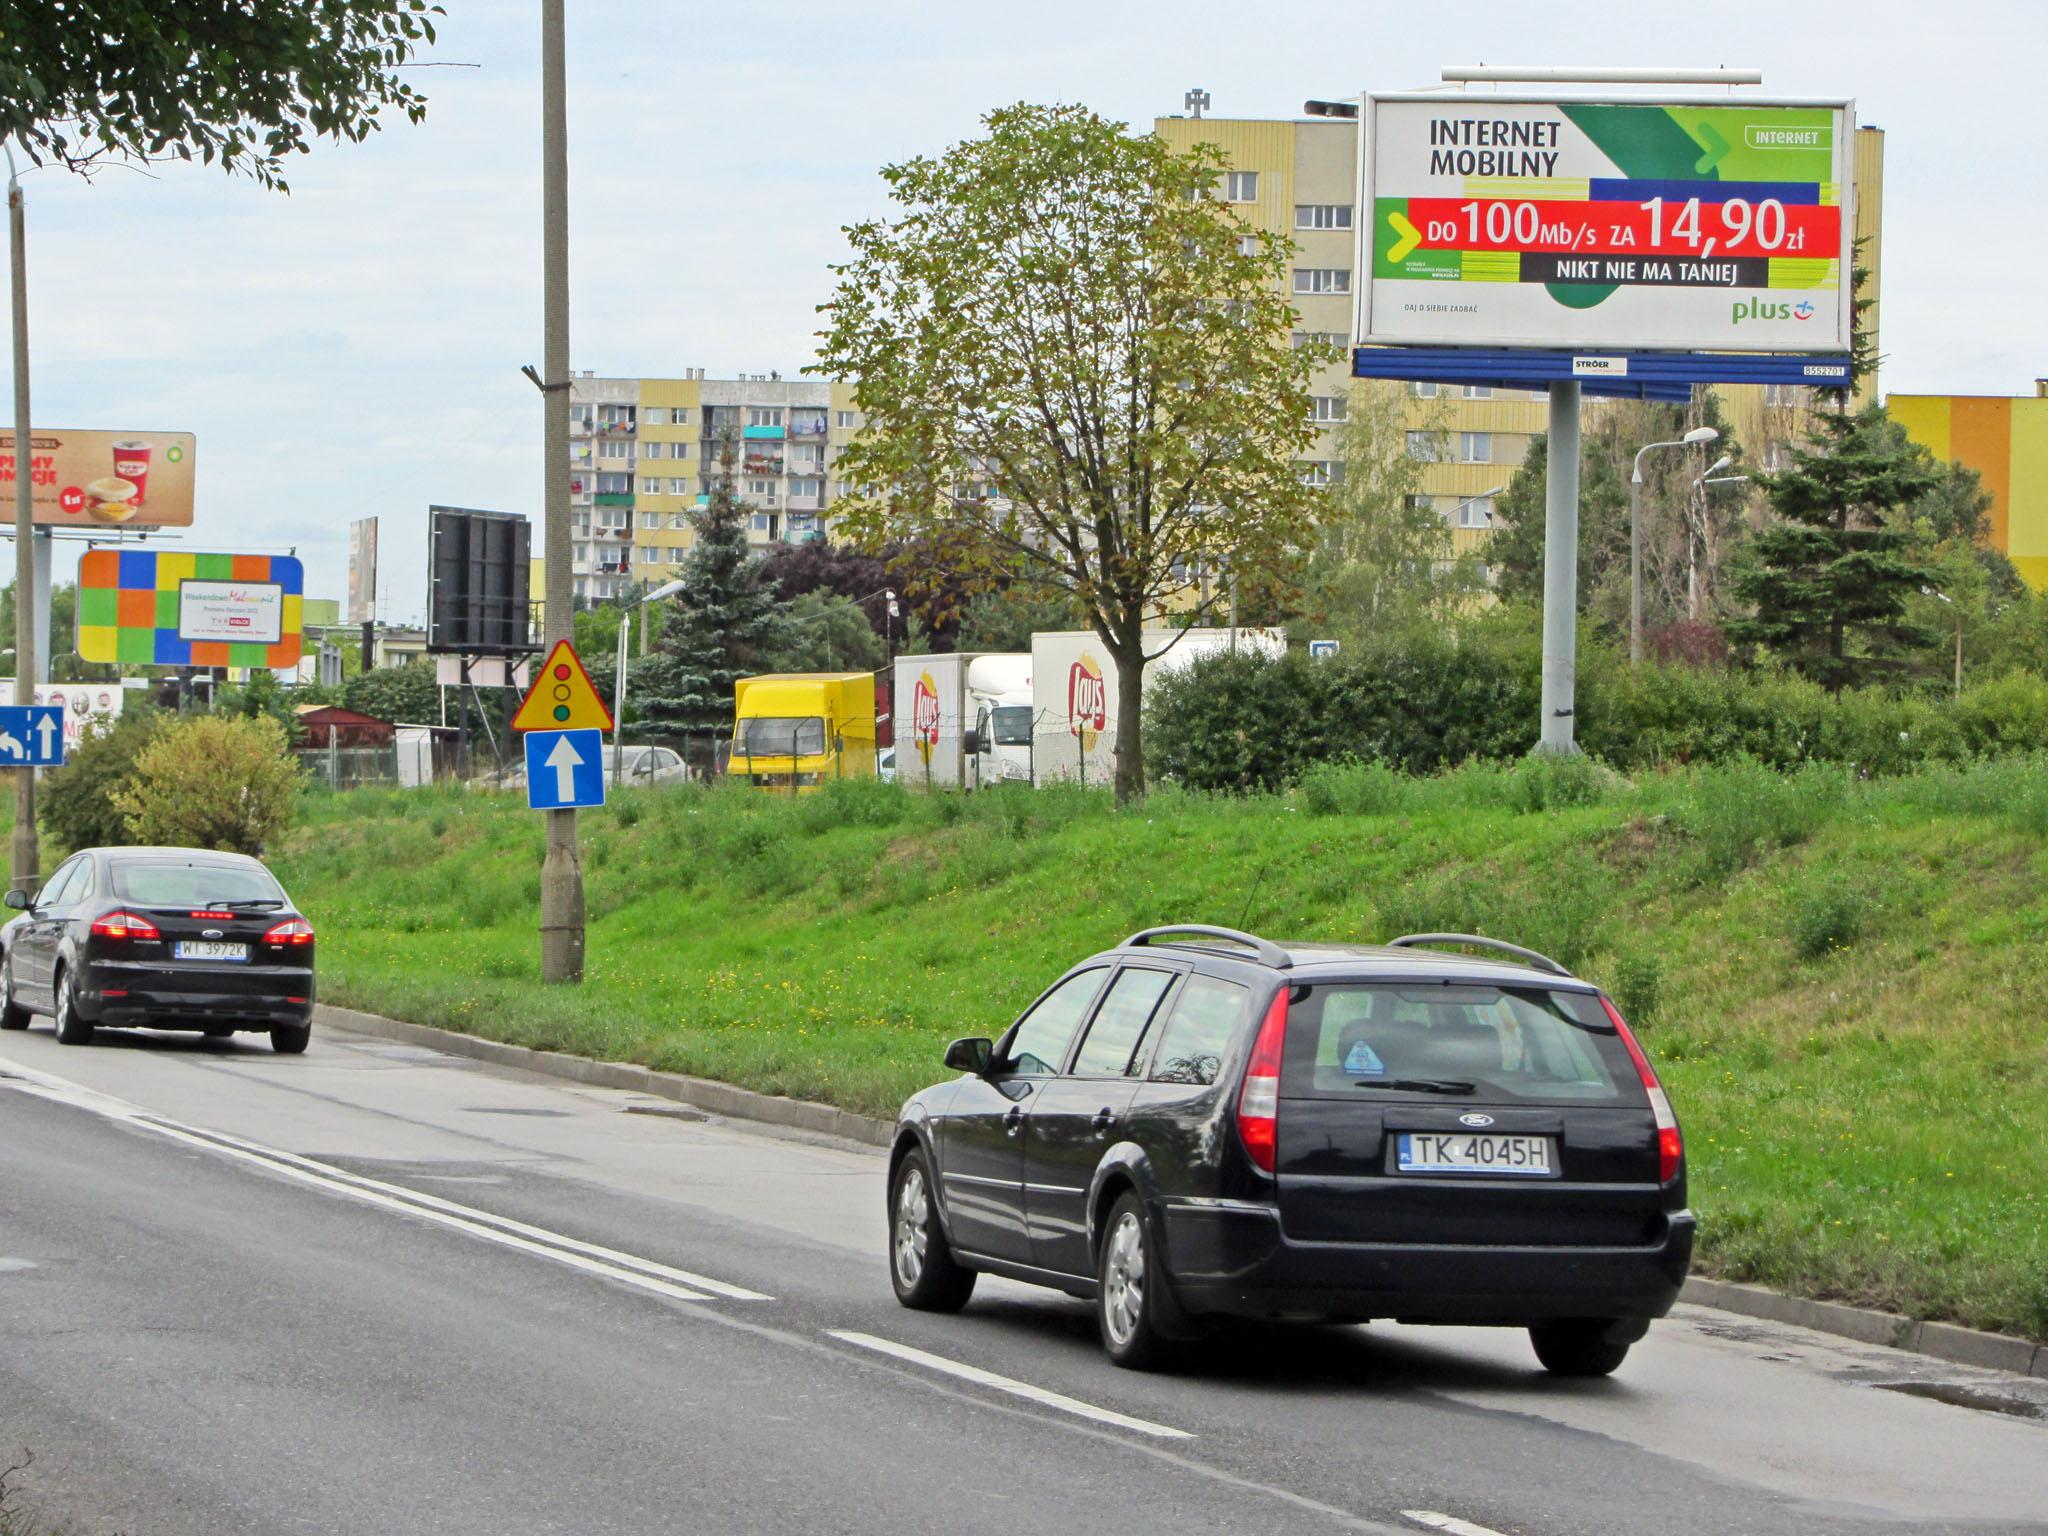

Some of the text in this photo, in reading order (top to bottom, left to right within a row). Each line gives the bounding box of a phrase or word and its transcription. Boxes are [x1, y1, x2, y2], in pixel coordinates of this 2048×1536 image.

[1430, 119, 1561, 148] INTERNET
[1430, 149, 1559, 178] MOBILNY
[1427, 220, 1457, 242] DO
[1609, 225, 1636, 247] ZA
[1557, 260, 1738, 286] NIKT NIE MA TANIEJ
[1404, 303, 1417, 313] DAJ
[1419, 304, 1424, 312] O
[1426, 304, 1448, 313] SIEBIE
[1732, 296, 1791, 325] plus
[206, 942, 246, 956] 3972K
[1416, 1136, 1454, 1163] TK
[1464, 1137, 1545, 1166] 4045H
